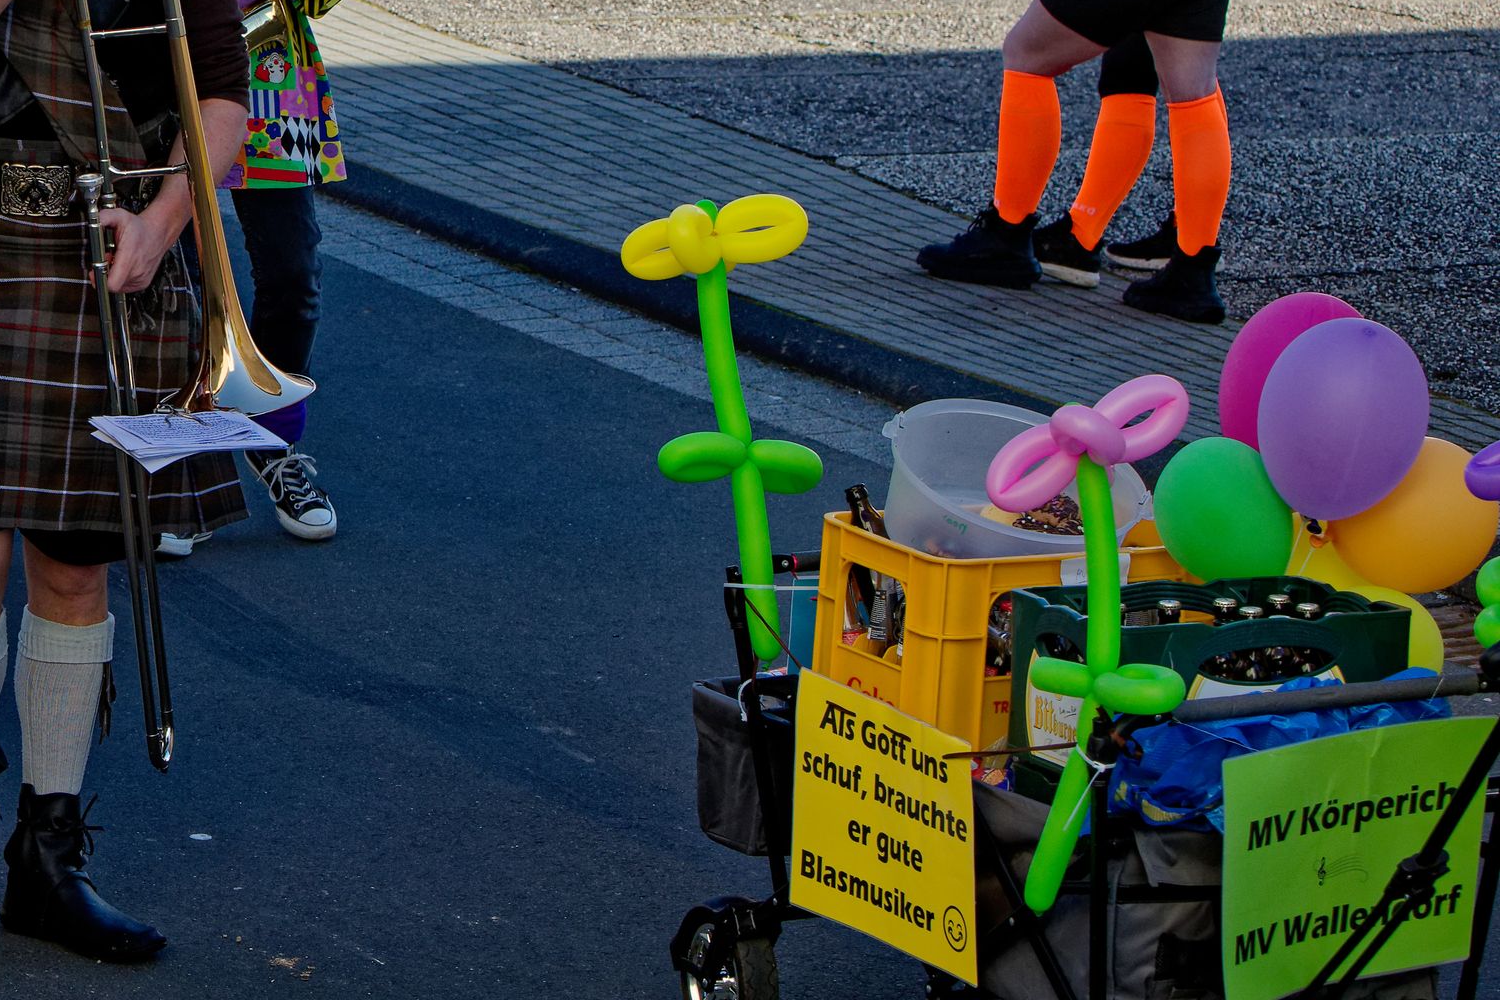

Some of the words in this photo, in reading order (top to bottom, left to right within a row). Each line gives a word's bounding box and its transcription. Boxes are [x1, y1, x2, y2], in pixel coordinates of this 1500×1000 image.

[861, 719, 911, 765] Gott
[912, 747, 948, 784] uns
[1034, 695, 1077, 743] Bitburge
[802, 750, 867, 801] schuf,
[874, 773, 967, 843] brauchte
[847, 820, 871, 846] er
[876, 831, 923, 872] gute
[1248, 809, 1296, 851] MV
[800, 848, 935, 932] Blasmusiker
[1235, 922, 1278, 966] MV
[1284, 884, 1463, 948] Walleorf
